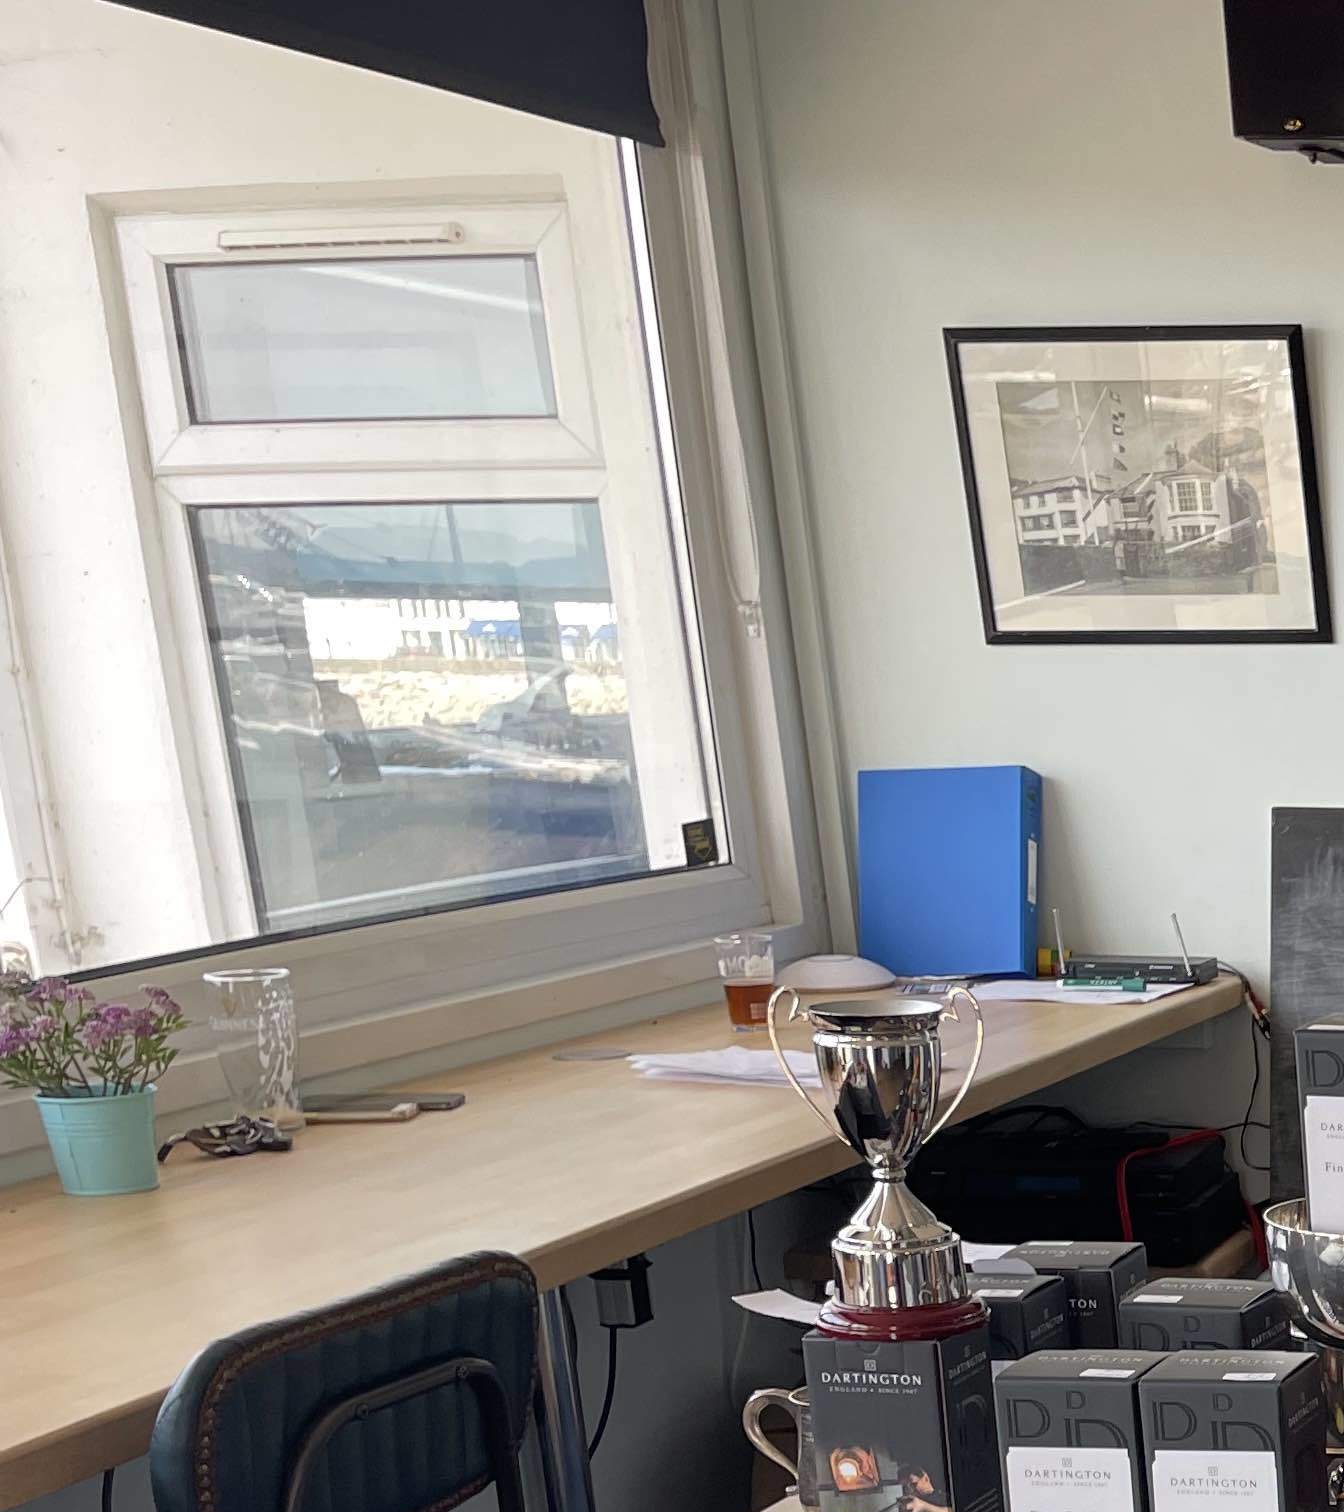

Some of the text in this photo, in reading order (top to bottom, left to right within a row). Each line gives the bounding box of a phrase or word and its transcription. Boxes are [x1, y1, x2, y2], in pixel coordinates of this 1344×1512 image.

[821, 1371, 922, 1386] DARTINGTON
[1024, 1469, 1112, 1480] DARTINGTON
[1170, 1477, 1258, 1489] DARTINGTON
